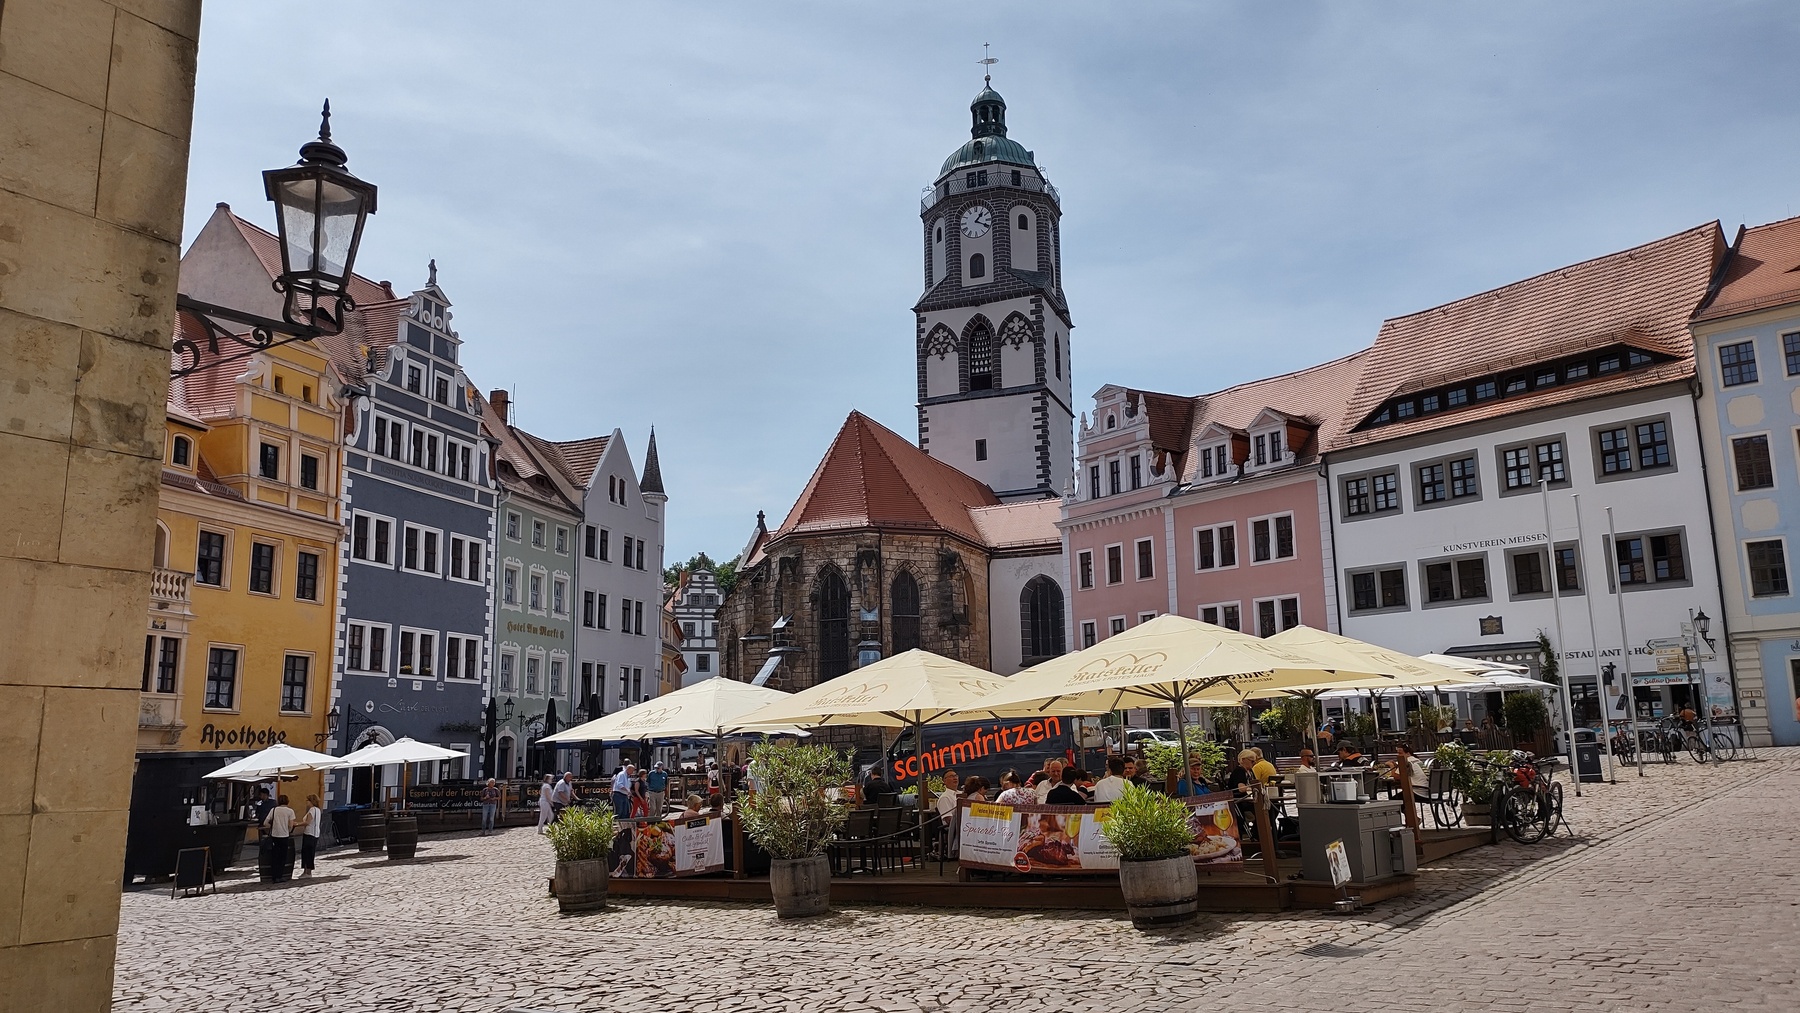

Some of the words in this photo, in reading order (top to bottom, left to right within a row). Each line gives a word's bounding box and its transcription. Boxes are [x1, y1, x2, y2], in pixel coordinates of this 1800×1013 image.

[1443, 537, 1506, 553] KUNSTVEREIN
[1508, 532, 1549, 545] MEISSEN
[506, 620, 526, 634] Hotel
[539, 625, 559, 639] Markt
[1555, 648, 1622, 661] ESTAUANT
[1067, 664, 1163, 683] Ratskeller
[1063, 679, 1101, 688] MEISSENS
[200, 723, 287, 750] Apotheke
[894, 716, 1061, 781] schirmfritzen
[409, 788, 430, 798] Essen
[431, 788, 444, 797] auf
[445, 788, 459, 797] der
[460, 787, 482, 797] Terras
[526, 786, 541, 796] Ess
